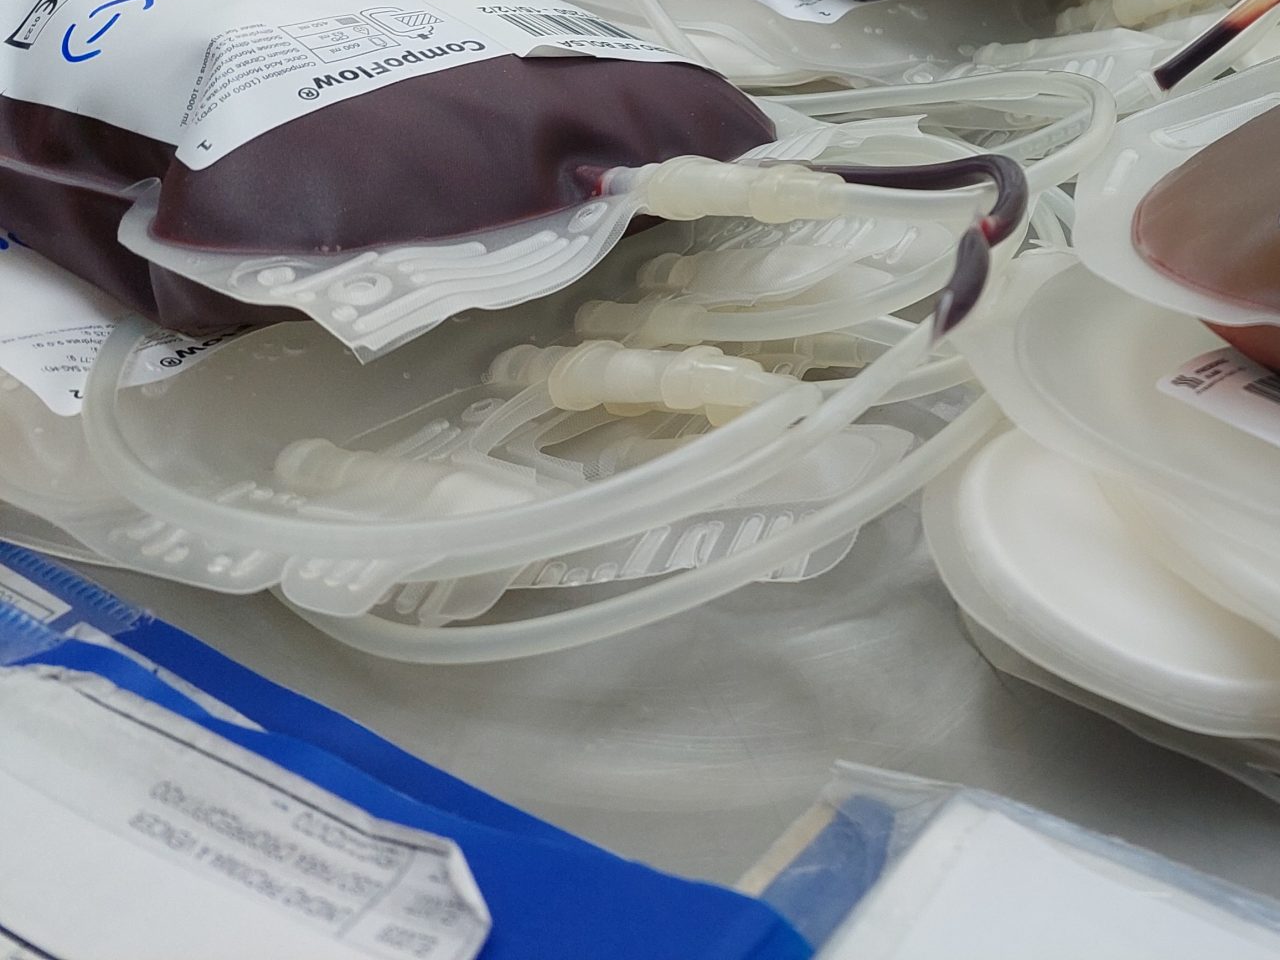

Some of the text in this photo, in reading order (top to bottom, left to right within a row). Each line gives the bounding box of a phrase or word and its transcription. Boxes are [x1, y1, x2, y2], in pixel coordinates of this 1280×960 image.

[22, 15, 42, 41] 0123
[234, 55, 267, 69] Citrate
[261, 61, 317, 80] Composition
[263, 60, 284, 71] Acid
[297, 40, 487, 101] CompoFlow®
[231, 76, 262, 94] (1000
[185, 88, 200, 112] 1000
[196, 139, 213, 152] 1
